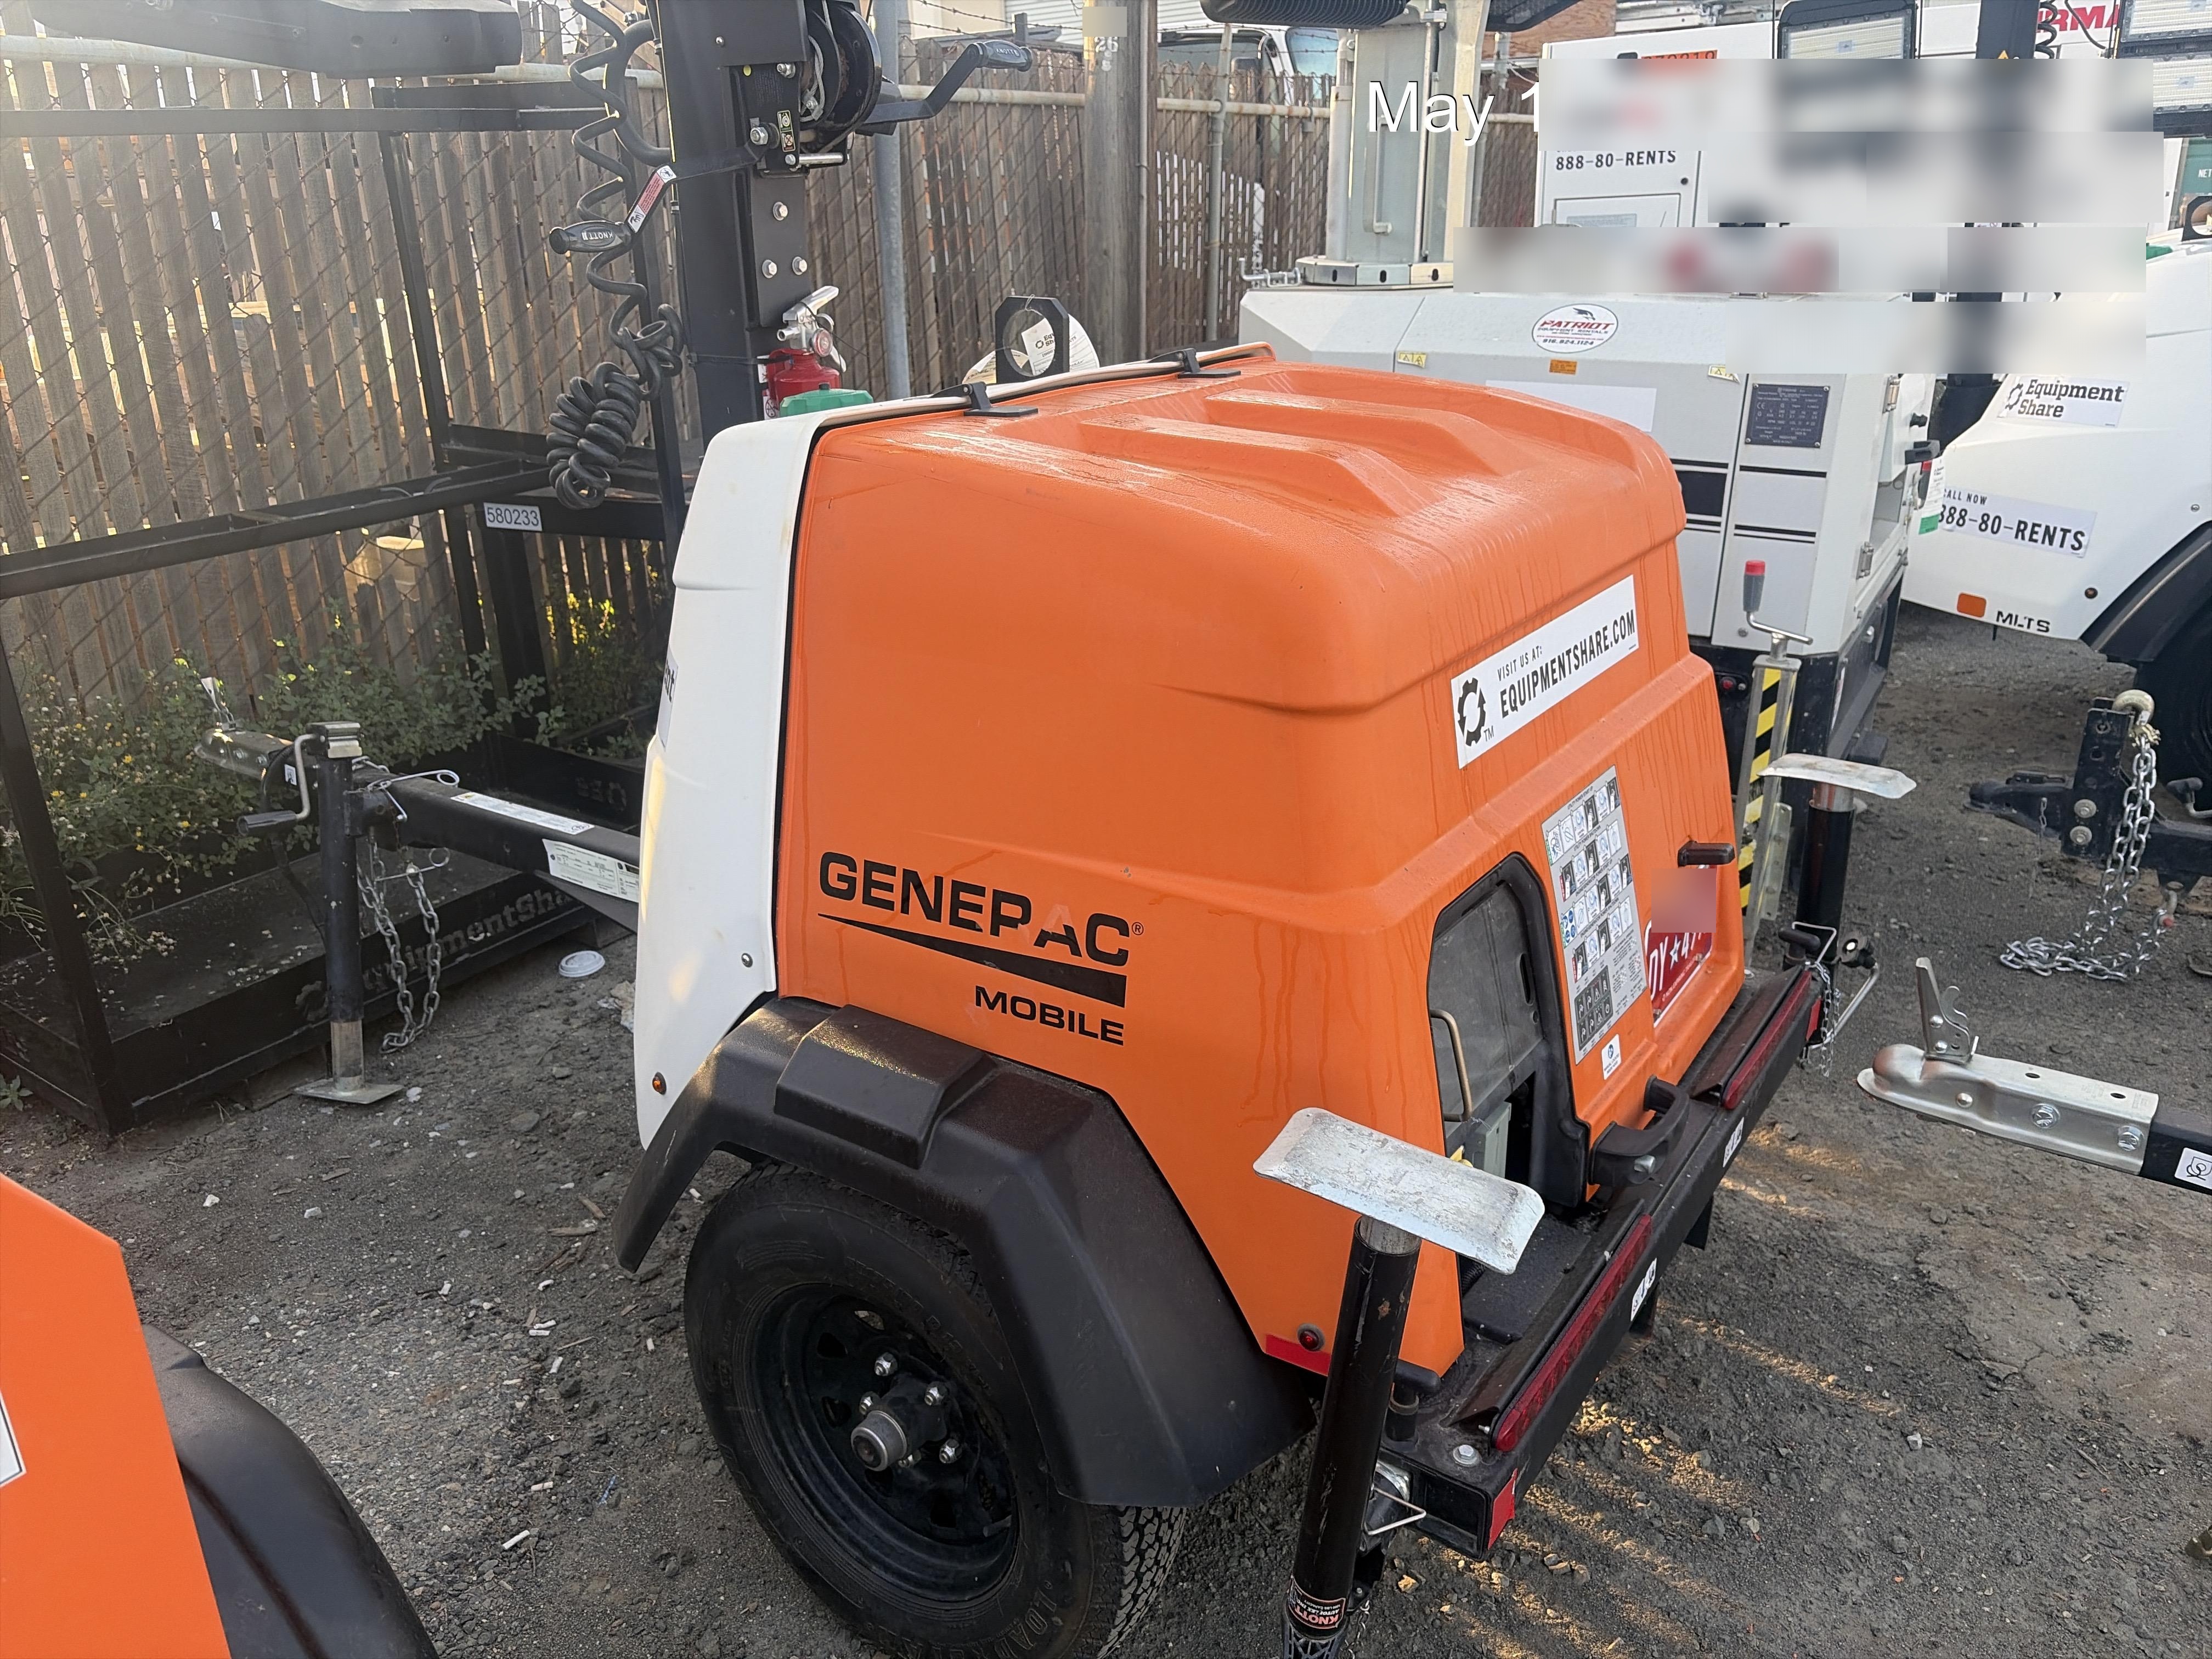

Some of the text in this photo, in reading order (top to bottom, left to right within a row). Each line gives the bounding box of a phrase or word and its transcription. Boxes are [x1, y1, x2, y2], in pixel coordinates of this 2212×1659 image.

[1556, 151, 1677, 170] 888-80-RENTS
[589, 232, 614, 240] KNOTT
[1539, 320, 1615, 330] PATRIOT
[2025, 379, 2125, 403] Equipment
[2018, 399, 2064, 418] Share
[1944, 488, 1987, 505] ALL NOW
[487, 507, 539, 526] 580233
[1996, 610, 2051, 633] MLTS
[1497, 645, 1543, 681] VISIT US AT:
[1500, 609, 1635, 719] EQUIPMENTSHARE.COM
[975, 985, 1124, 1046] MOBILE
[1295, 1605, 1339, 1624] KNOTT
